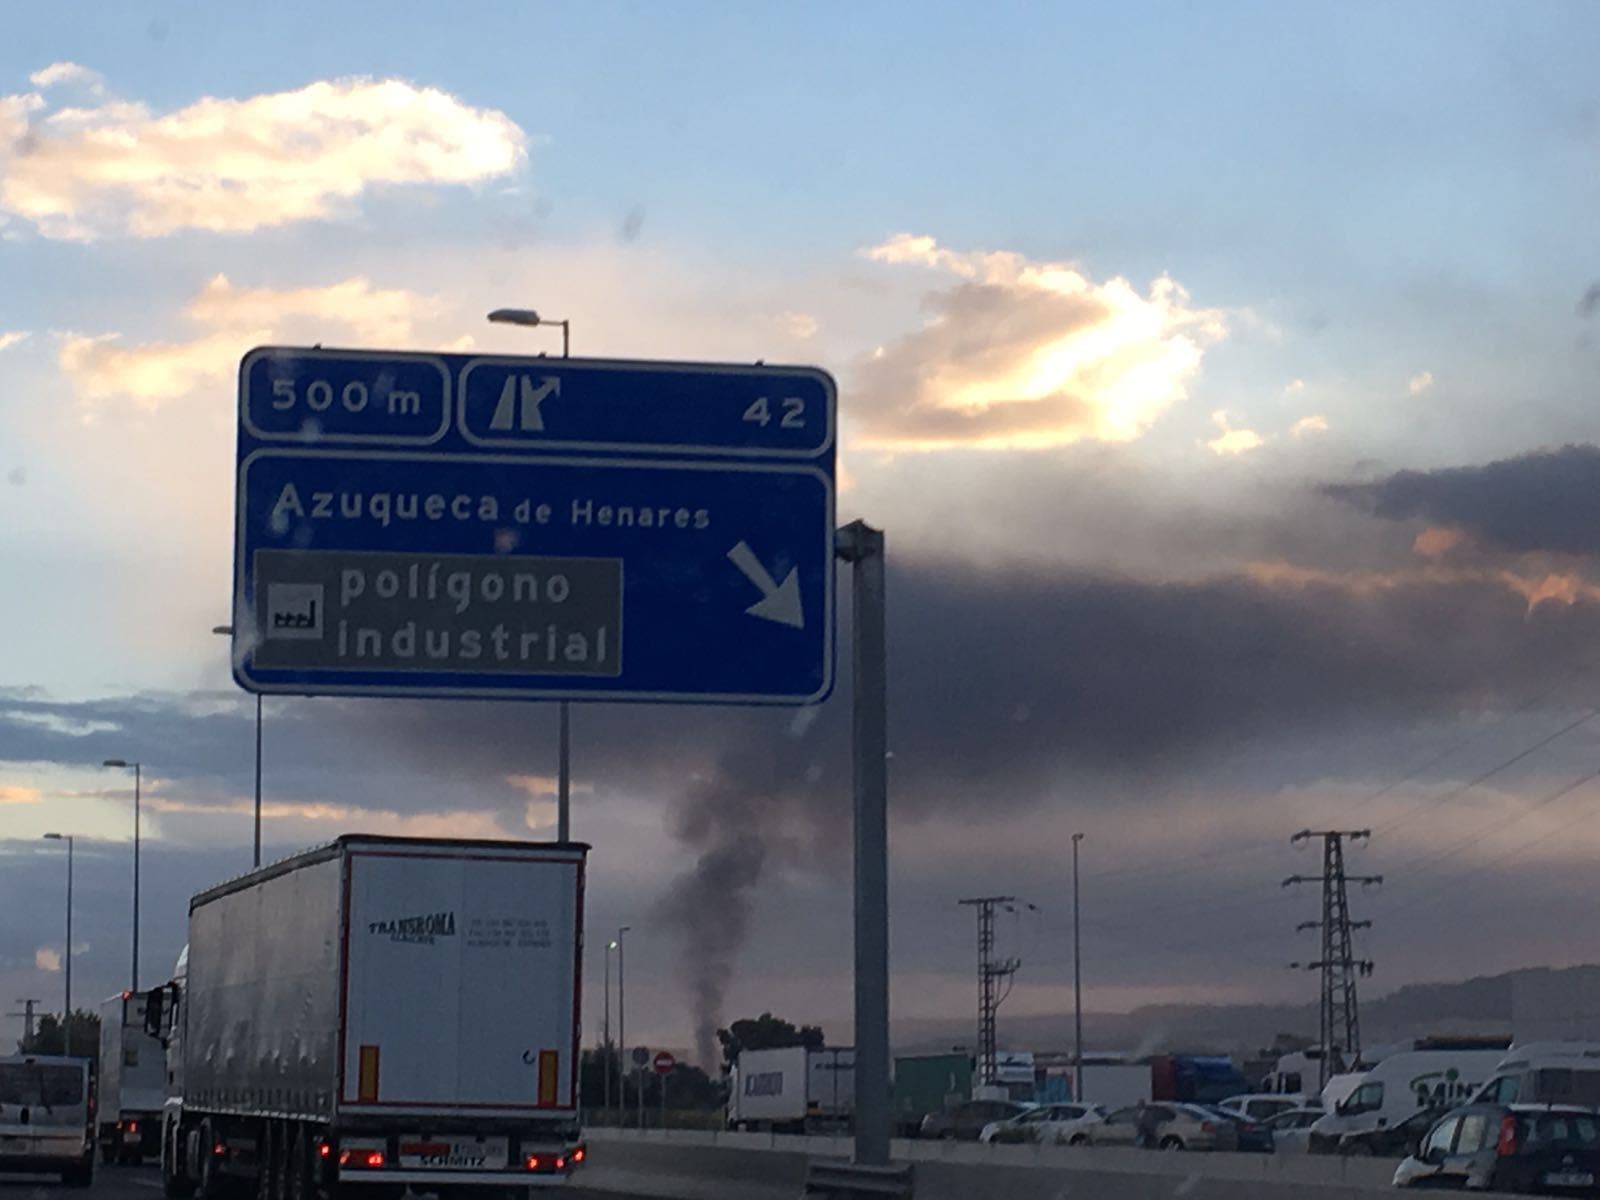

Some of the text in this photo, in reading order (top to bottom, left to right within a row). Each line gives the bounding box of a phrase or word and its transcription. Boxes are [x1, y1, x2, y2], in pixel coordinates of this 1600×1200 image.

[271, 379, 421, 415] 500 m
[742, 396, 806, 428] 42
[272, 482, 711, 530] Azuqueca de Henares
[339, 562, 570, 614] polígono
[337, 619, 608, 664] industrial
